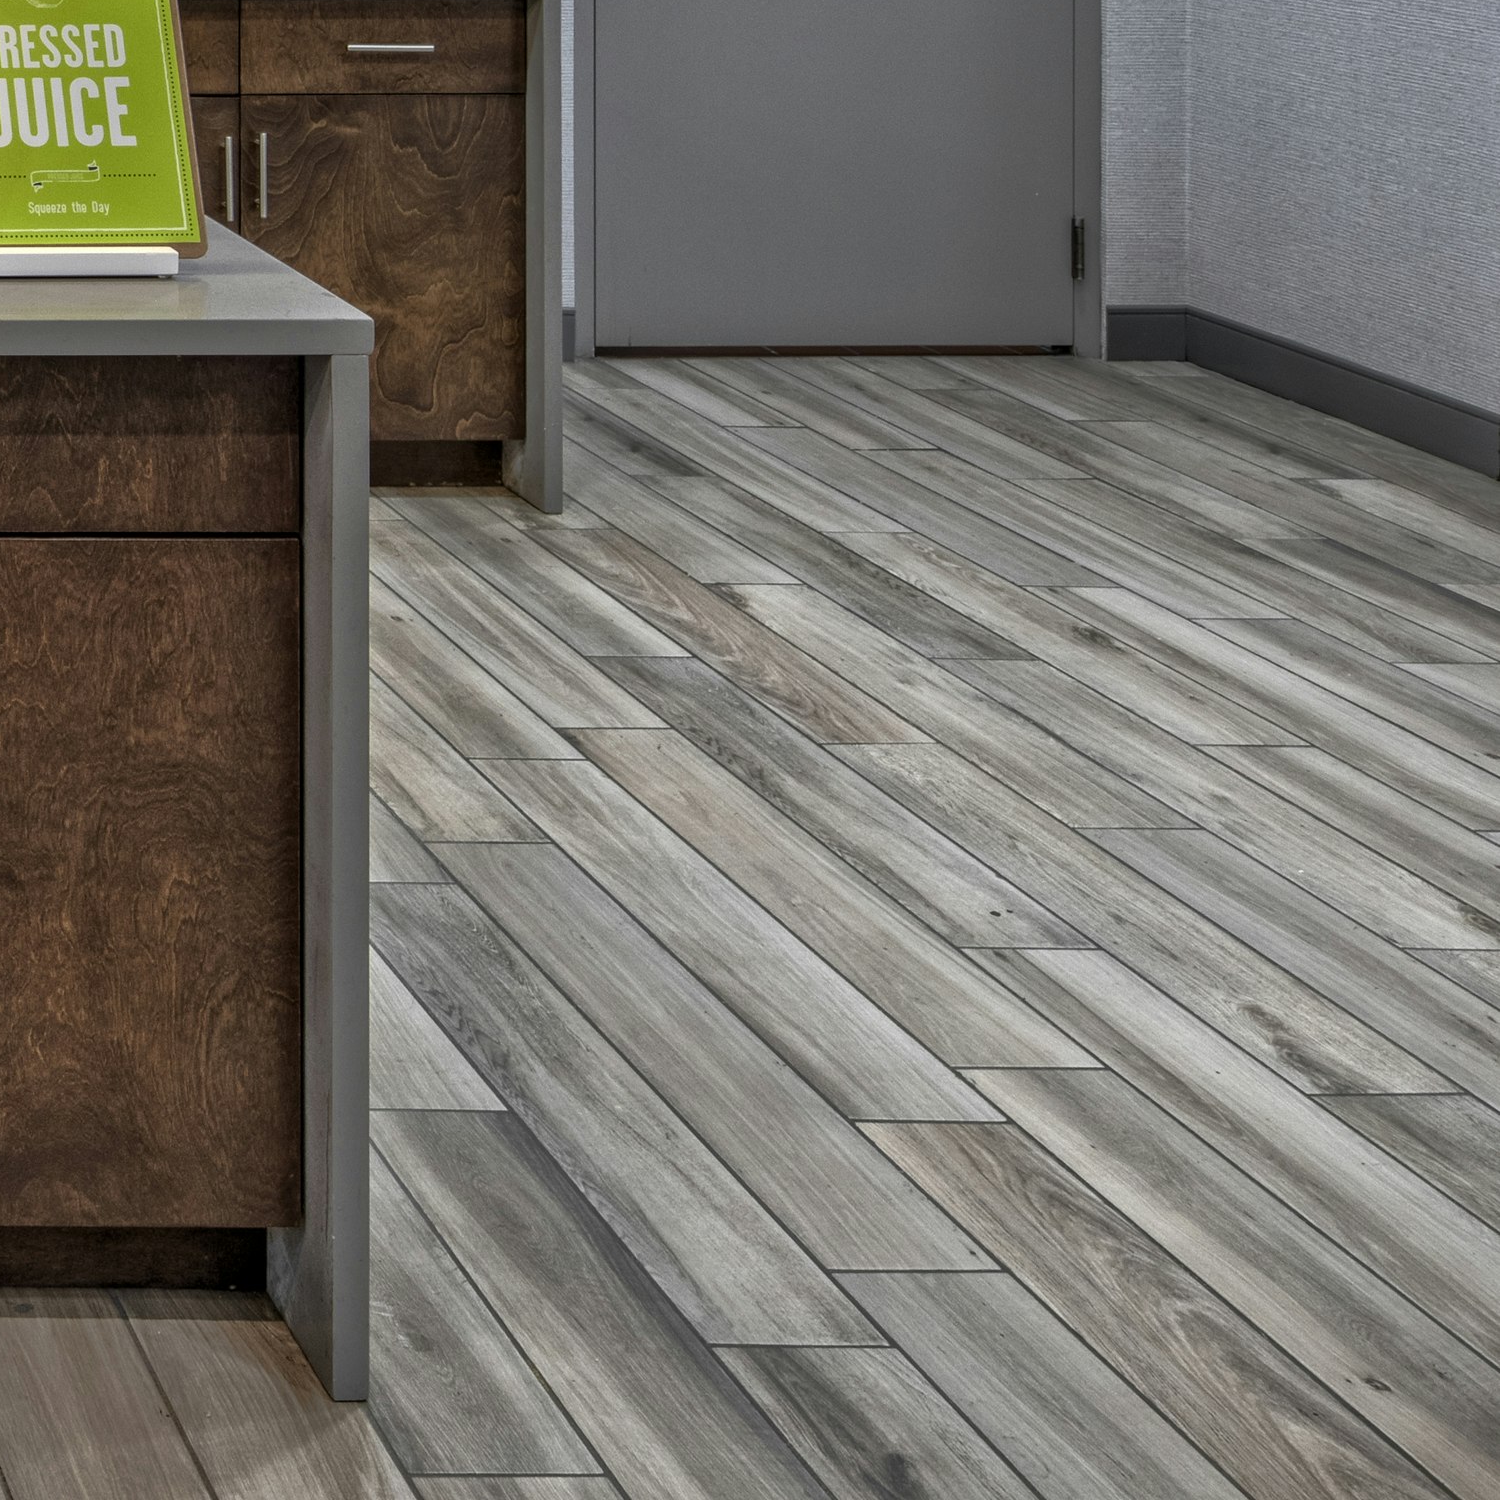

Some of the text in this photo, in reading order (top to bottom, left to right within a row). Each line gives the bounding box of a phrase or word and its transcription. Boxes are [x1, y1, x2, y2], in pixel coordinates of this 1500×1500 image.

[28, 201, 110, 216] Squeeze the Day
